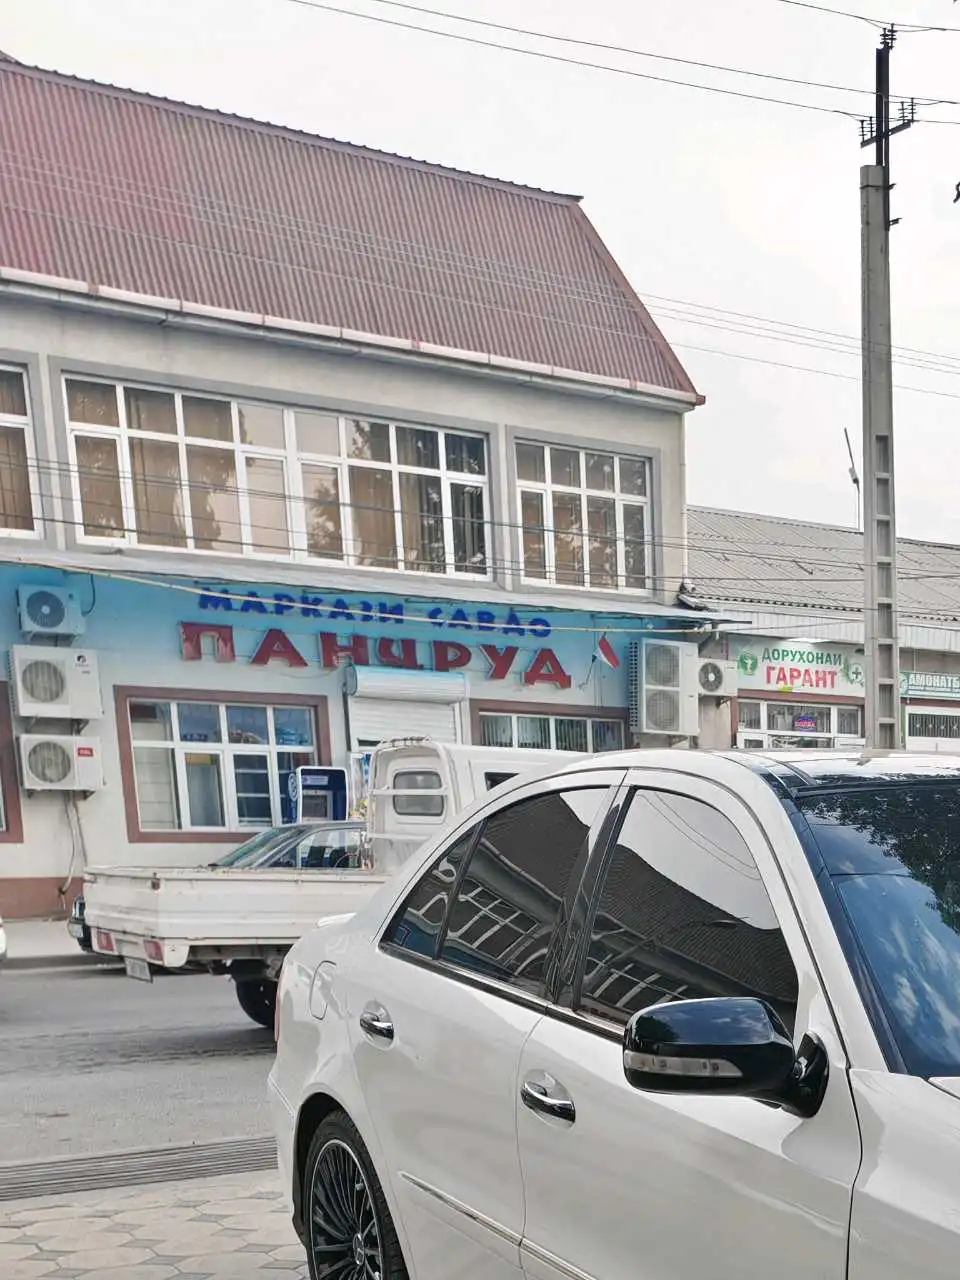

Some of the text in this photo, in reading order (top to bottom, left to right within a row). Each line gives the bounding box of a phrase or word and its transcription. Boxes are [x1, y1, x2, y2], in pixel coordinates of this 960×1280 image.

[198, 587, 552, 638] МАРКАЗИ САВДО
[766, 664, 838, 689] ГАРАНТ
